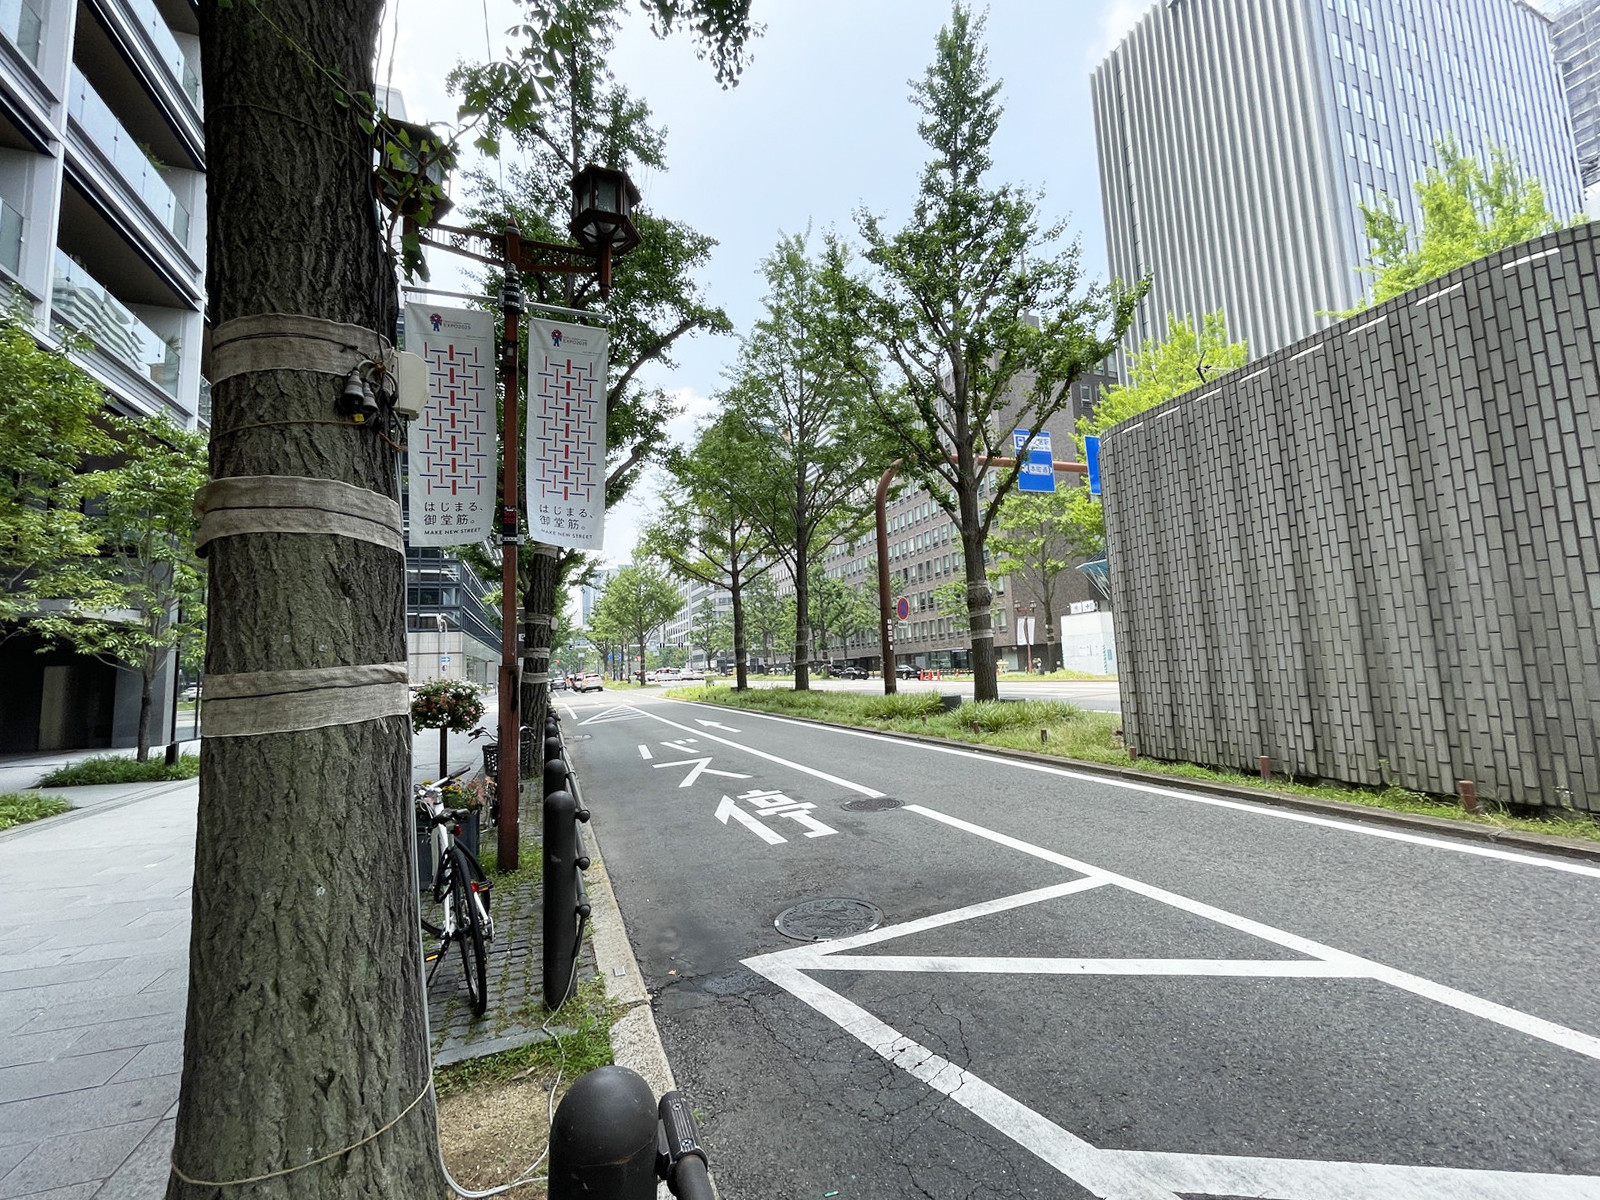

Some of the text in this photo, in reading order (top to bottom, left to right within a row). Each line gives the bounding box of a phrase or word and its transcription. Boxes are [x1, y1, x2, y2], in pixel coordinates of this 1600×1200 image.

[424, 502, 484, 512] はじまる、
[539, 504, 593, 518] はじまる、
[424, 514, 475, 525] 御堂筋。
[539, 514, 586, 530] 御堂筋。
